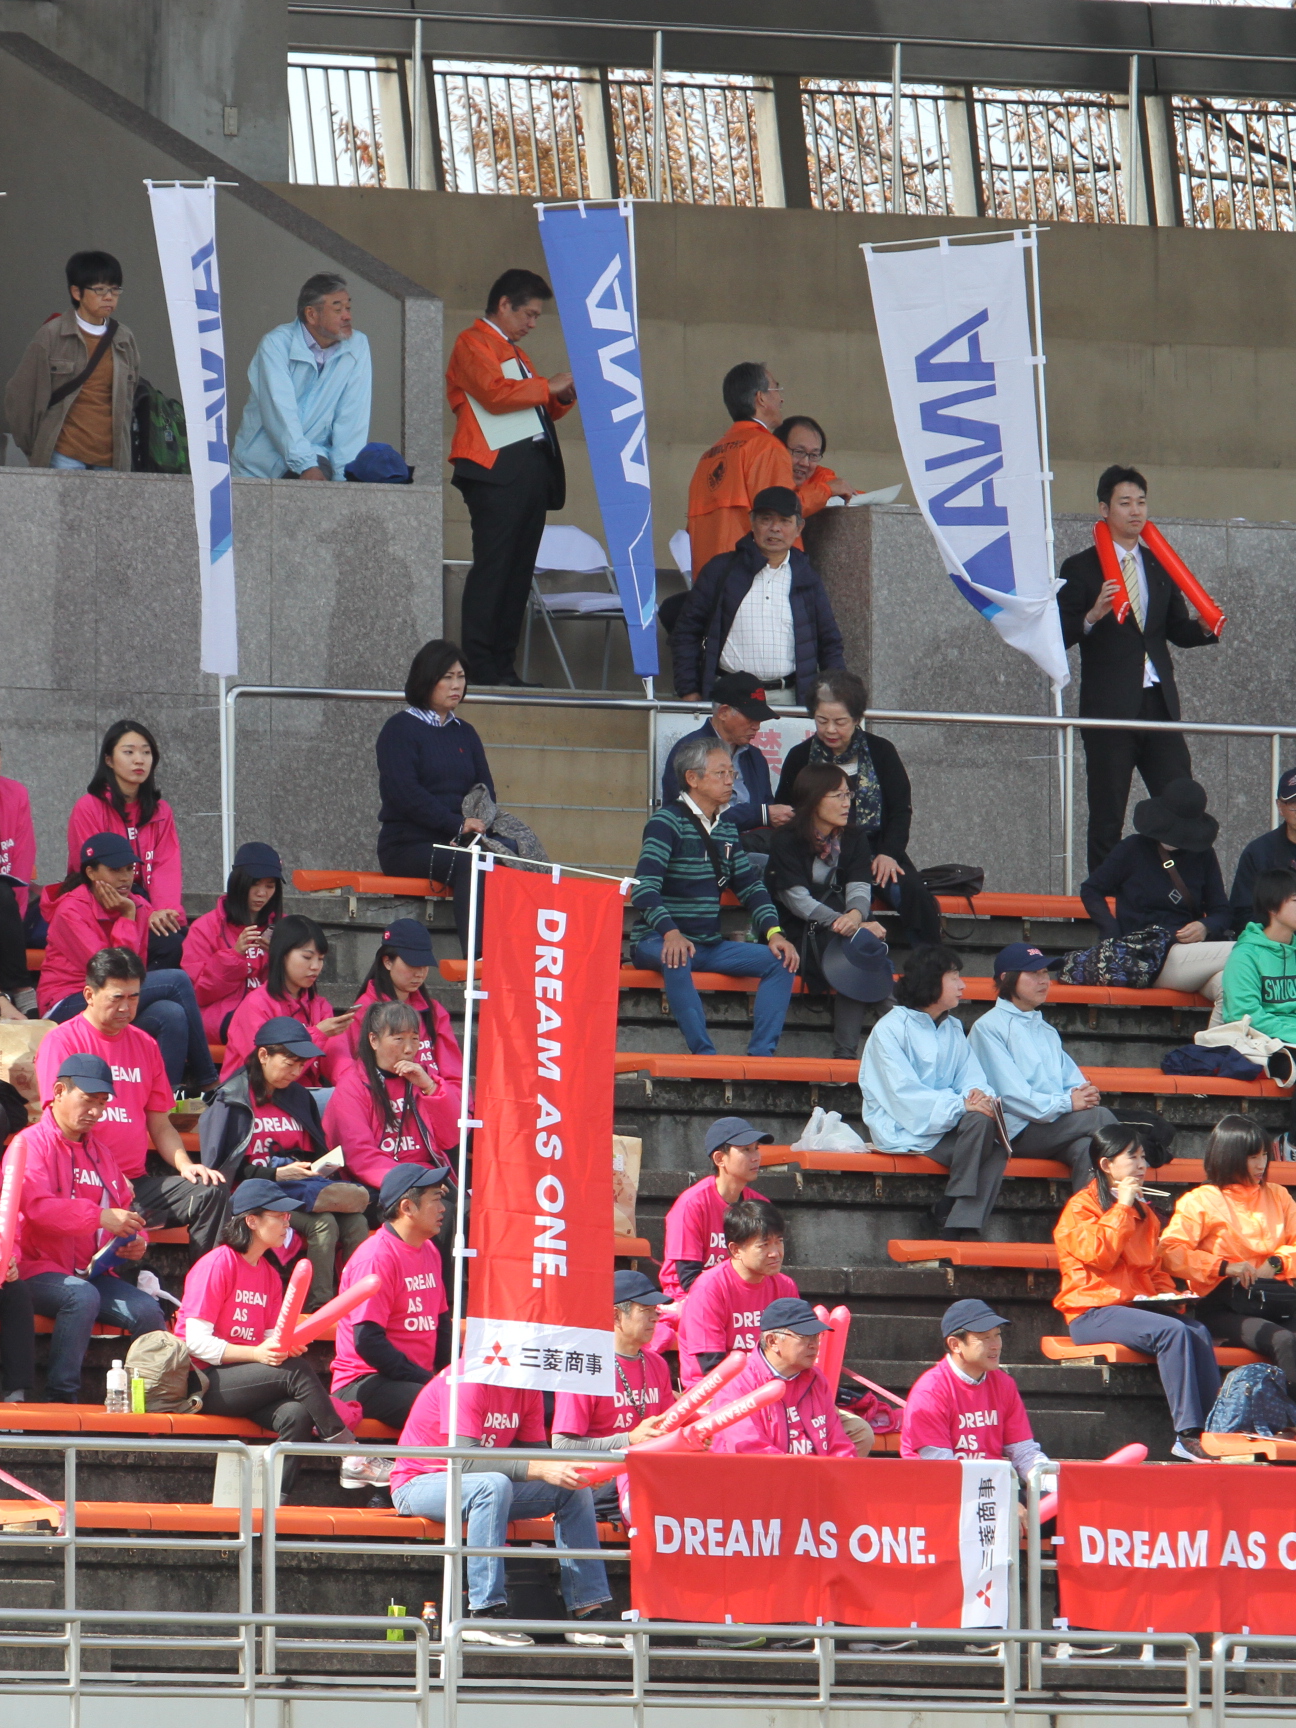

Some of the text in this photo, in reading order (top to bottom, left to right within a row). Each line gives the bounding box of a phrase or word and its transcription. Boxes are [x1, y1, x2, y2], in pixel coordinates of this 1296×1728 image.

[110, 1065, 142, 1083] EAM
[532, 908, 567, 1288] DREAM AS ONE.
[407, 1297, 423, 1313] AS
[233, 1307, 248, 1322] AS
[733, 1312, 761, 1328] DRE
[230, 1326, 256, 1341] ONE.
[733, 1334, 755, 1349] AS
[520, 1347, 603, 1376] 三菱商事
[690, 1372, 723, 1404] DREAM
[613, 1388, 659, 1408] DREAM
[677, 1399, 691, 1414] AS
[714, 1396, 757, 1426] DREAM
[613, 1413, 634, 1429] AS
[955, 1434, 979, 1450] AS
[976, 1477, 997, 1571] 三菱商事
[654, 1515, 936, 1564] DREAM AS ONE.
[1079, 1525, 1205, 1569] DREAM
[1220, 1529, 1266, 1569] AS
